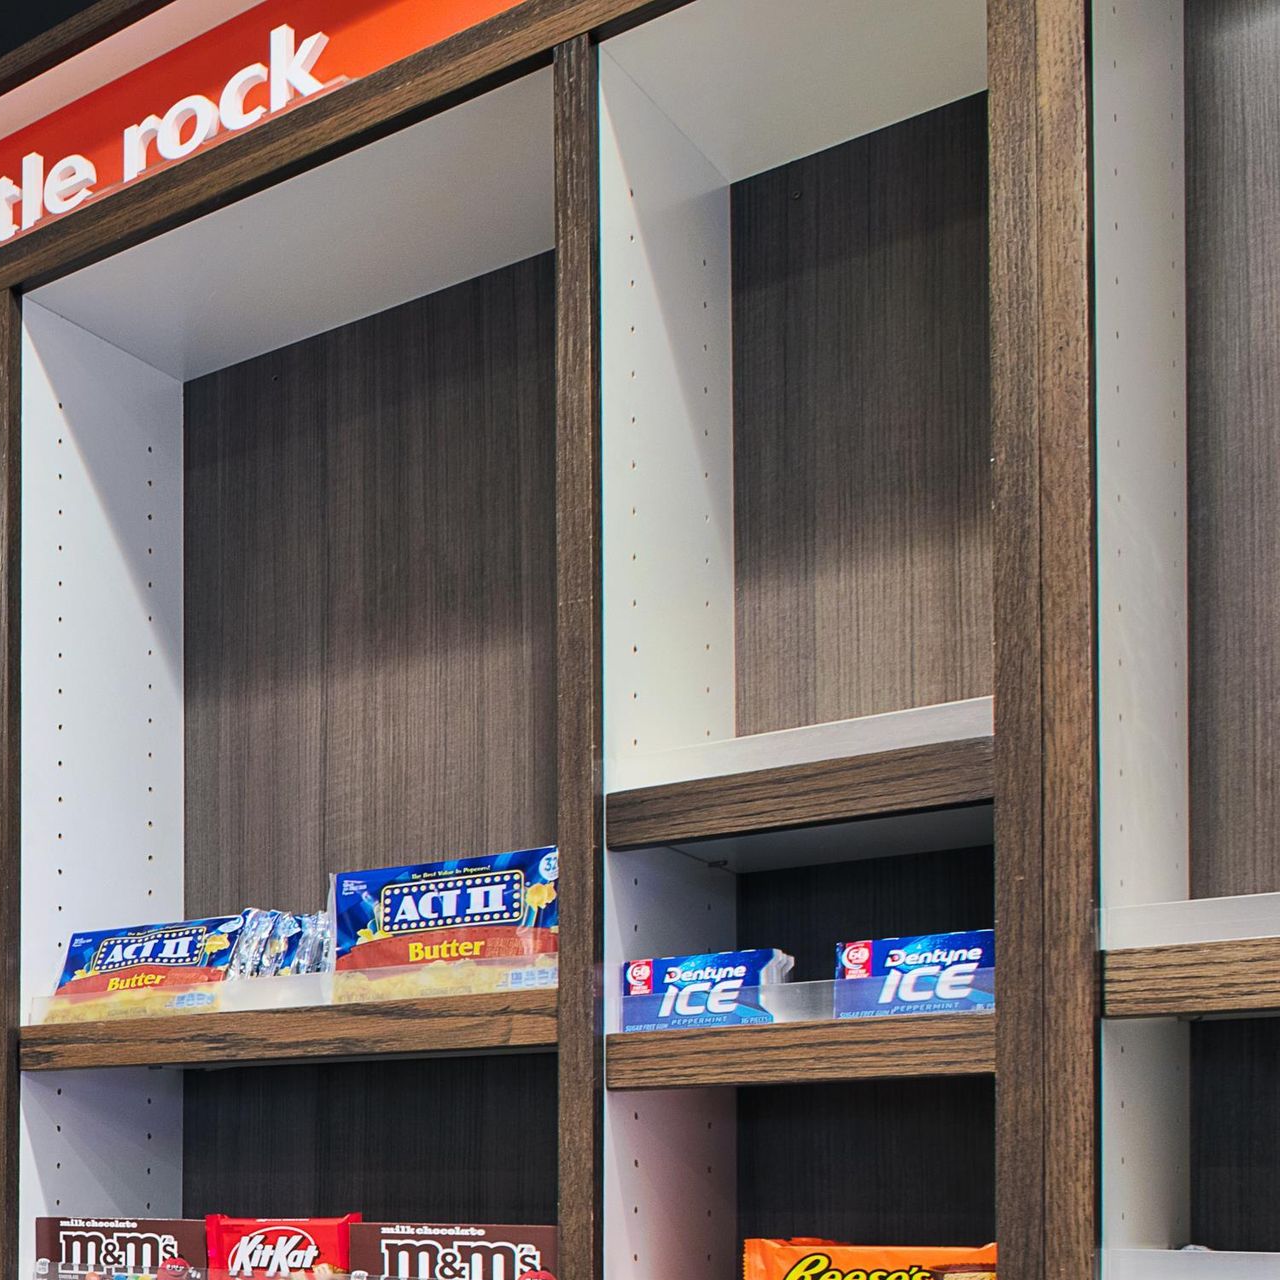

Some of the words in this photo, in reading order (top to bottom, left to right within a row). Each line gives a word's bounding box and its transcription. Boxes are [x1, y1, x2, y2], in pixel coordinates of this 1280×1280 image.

[124, 24, 329, 184] rock
[394, 889, 462, 923] ACT
[465, 883, 507, 915] II
[104, 939, 161, 965] ACT
[157, 936, 191, 959] II
[408, 938, 486, 962] Butter
[884, 947, 983, 968] Dentyne
[107, 972, 167, 992] Butter
[663, 965, 747, 984] Dentyne
[878, 962, 980, 1005] ICE
[657, 979, 744, 1018] ICE
[893, 1002, 960, 1012] PEPPERMINT
[671, 1015, 728, 1026] PEPPERMINT
[59, 1219, 85, 1229] milk
[85, 1219, 138, 1229] chocolate
[381, 1225, 415, 1235] milk
[415, 1226, 486, 1237] chocolate
